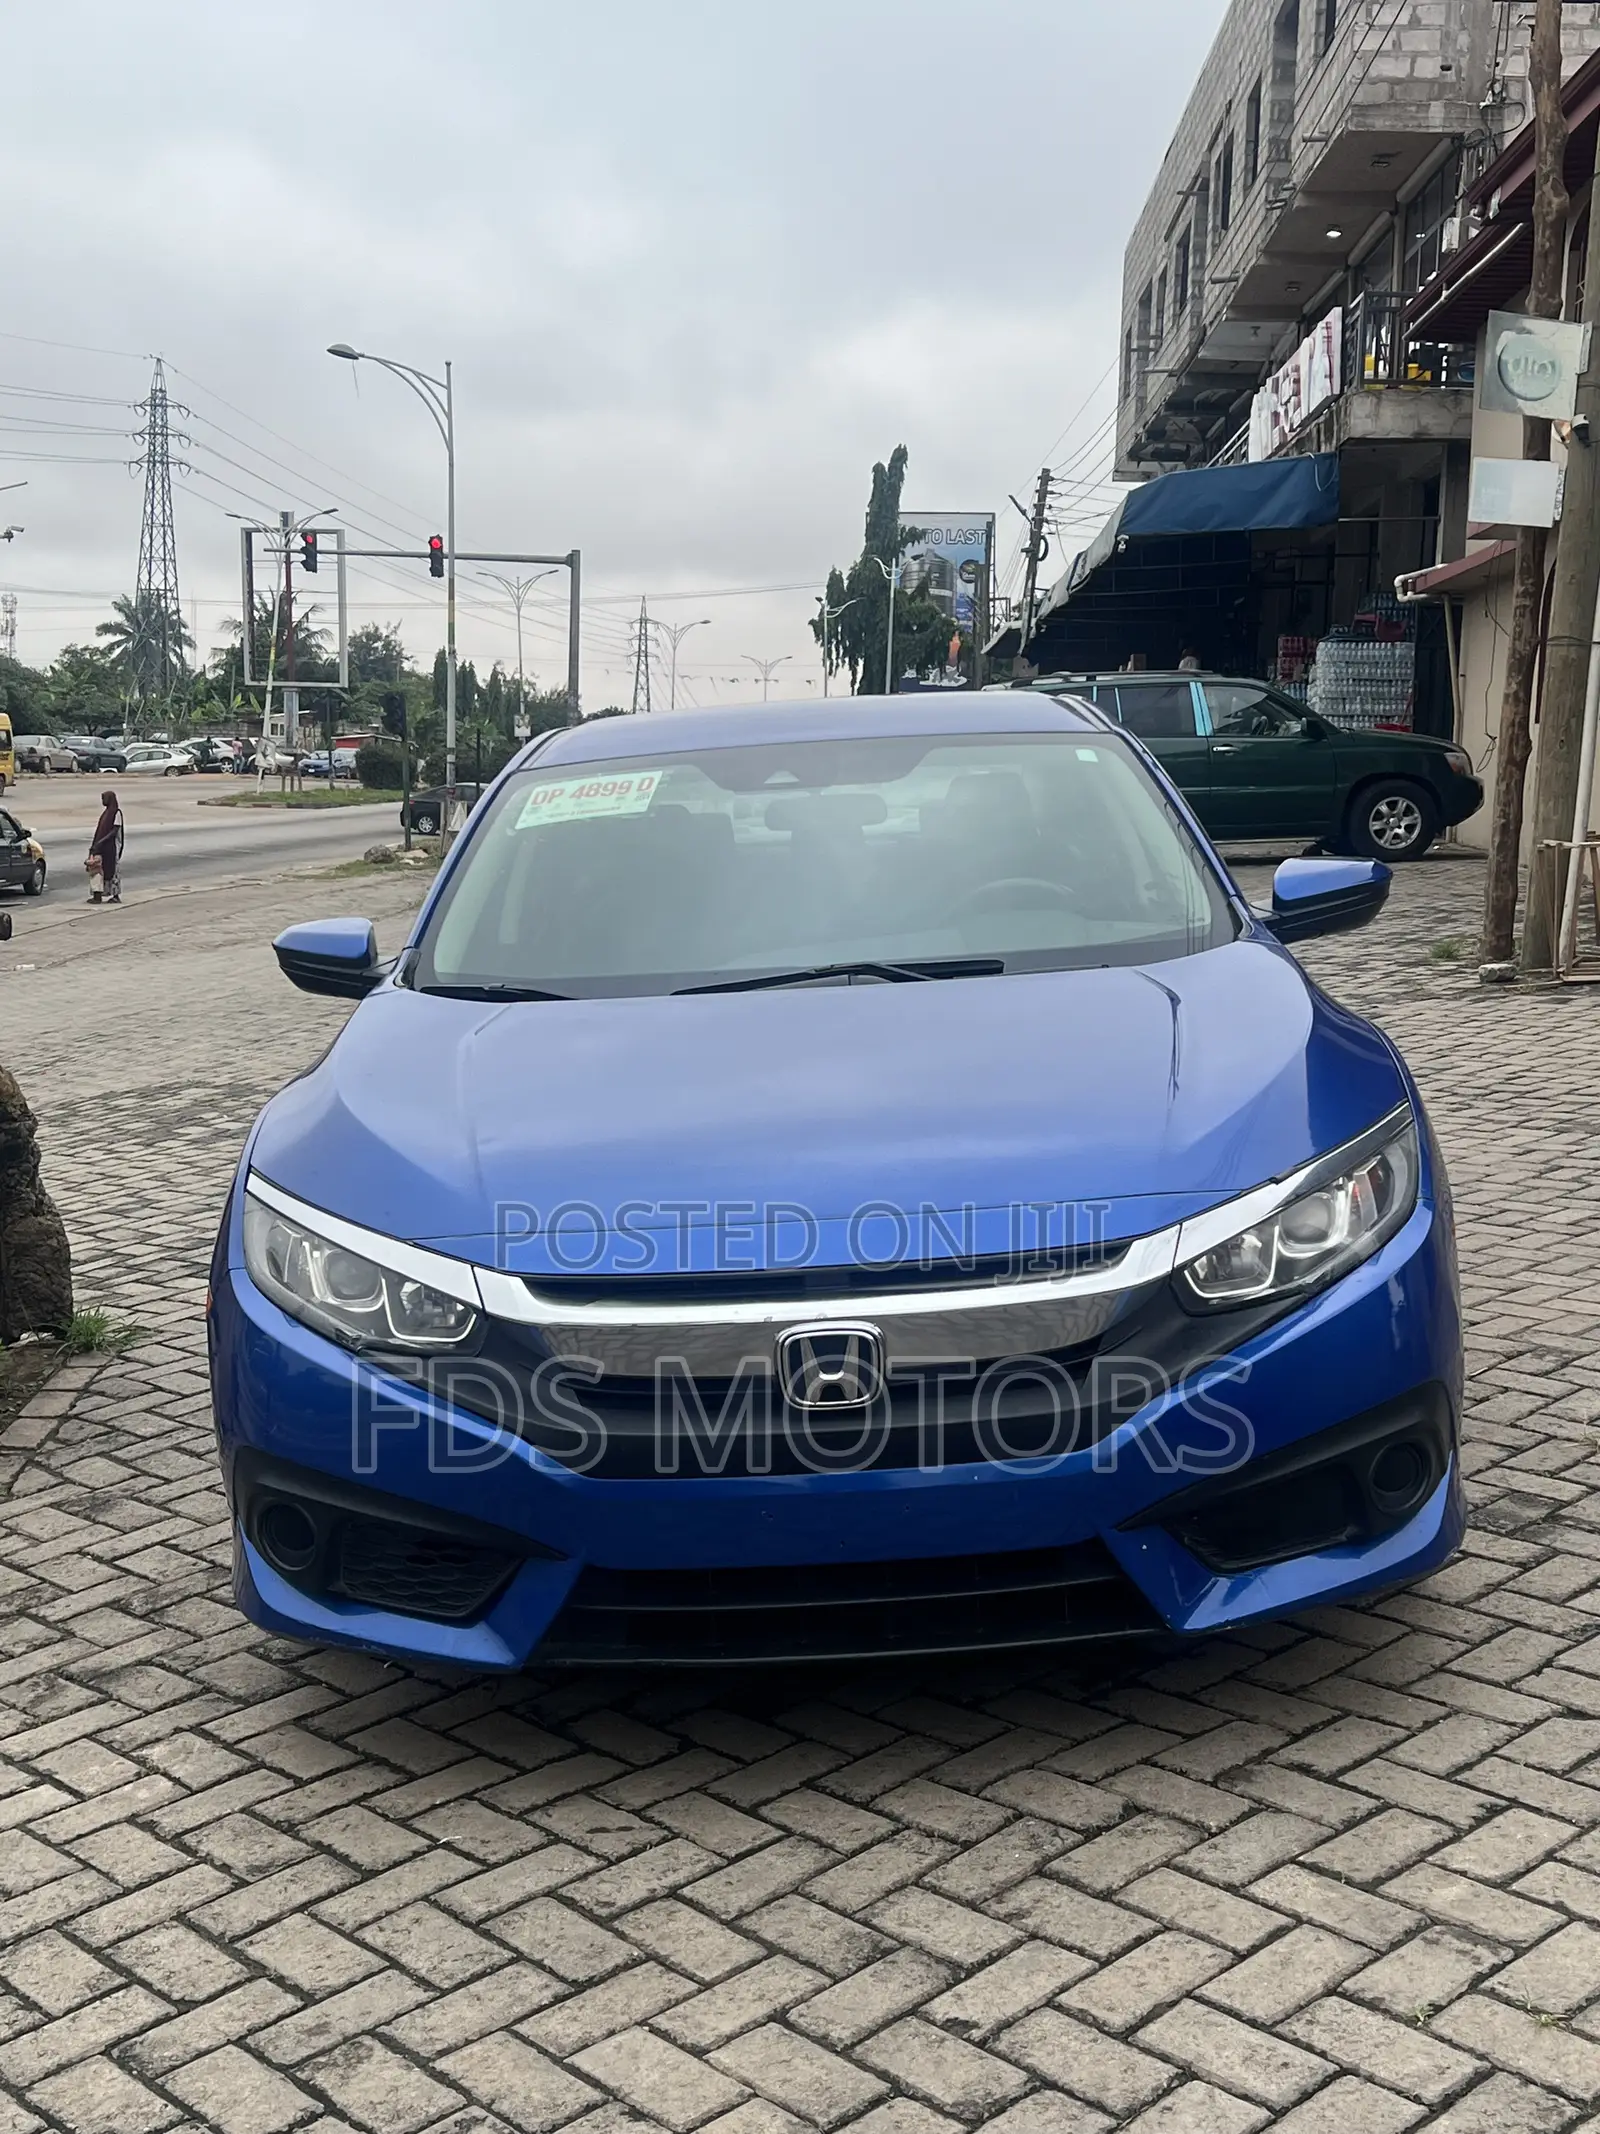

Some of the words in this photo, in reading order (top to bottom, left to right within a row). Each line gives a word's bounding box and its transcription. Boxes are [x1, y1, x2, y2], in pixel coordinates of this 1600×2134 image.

[923, 528, 943, 545] TO
[945, 528, 985, 545] LAST
[530, 789, 564, 806] DP
[569, 781, 633, 799] 4899
[636, 776, 655, 792] D
